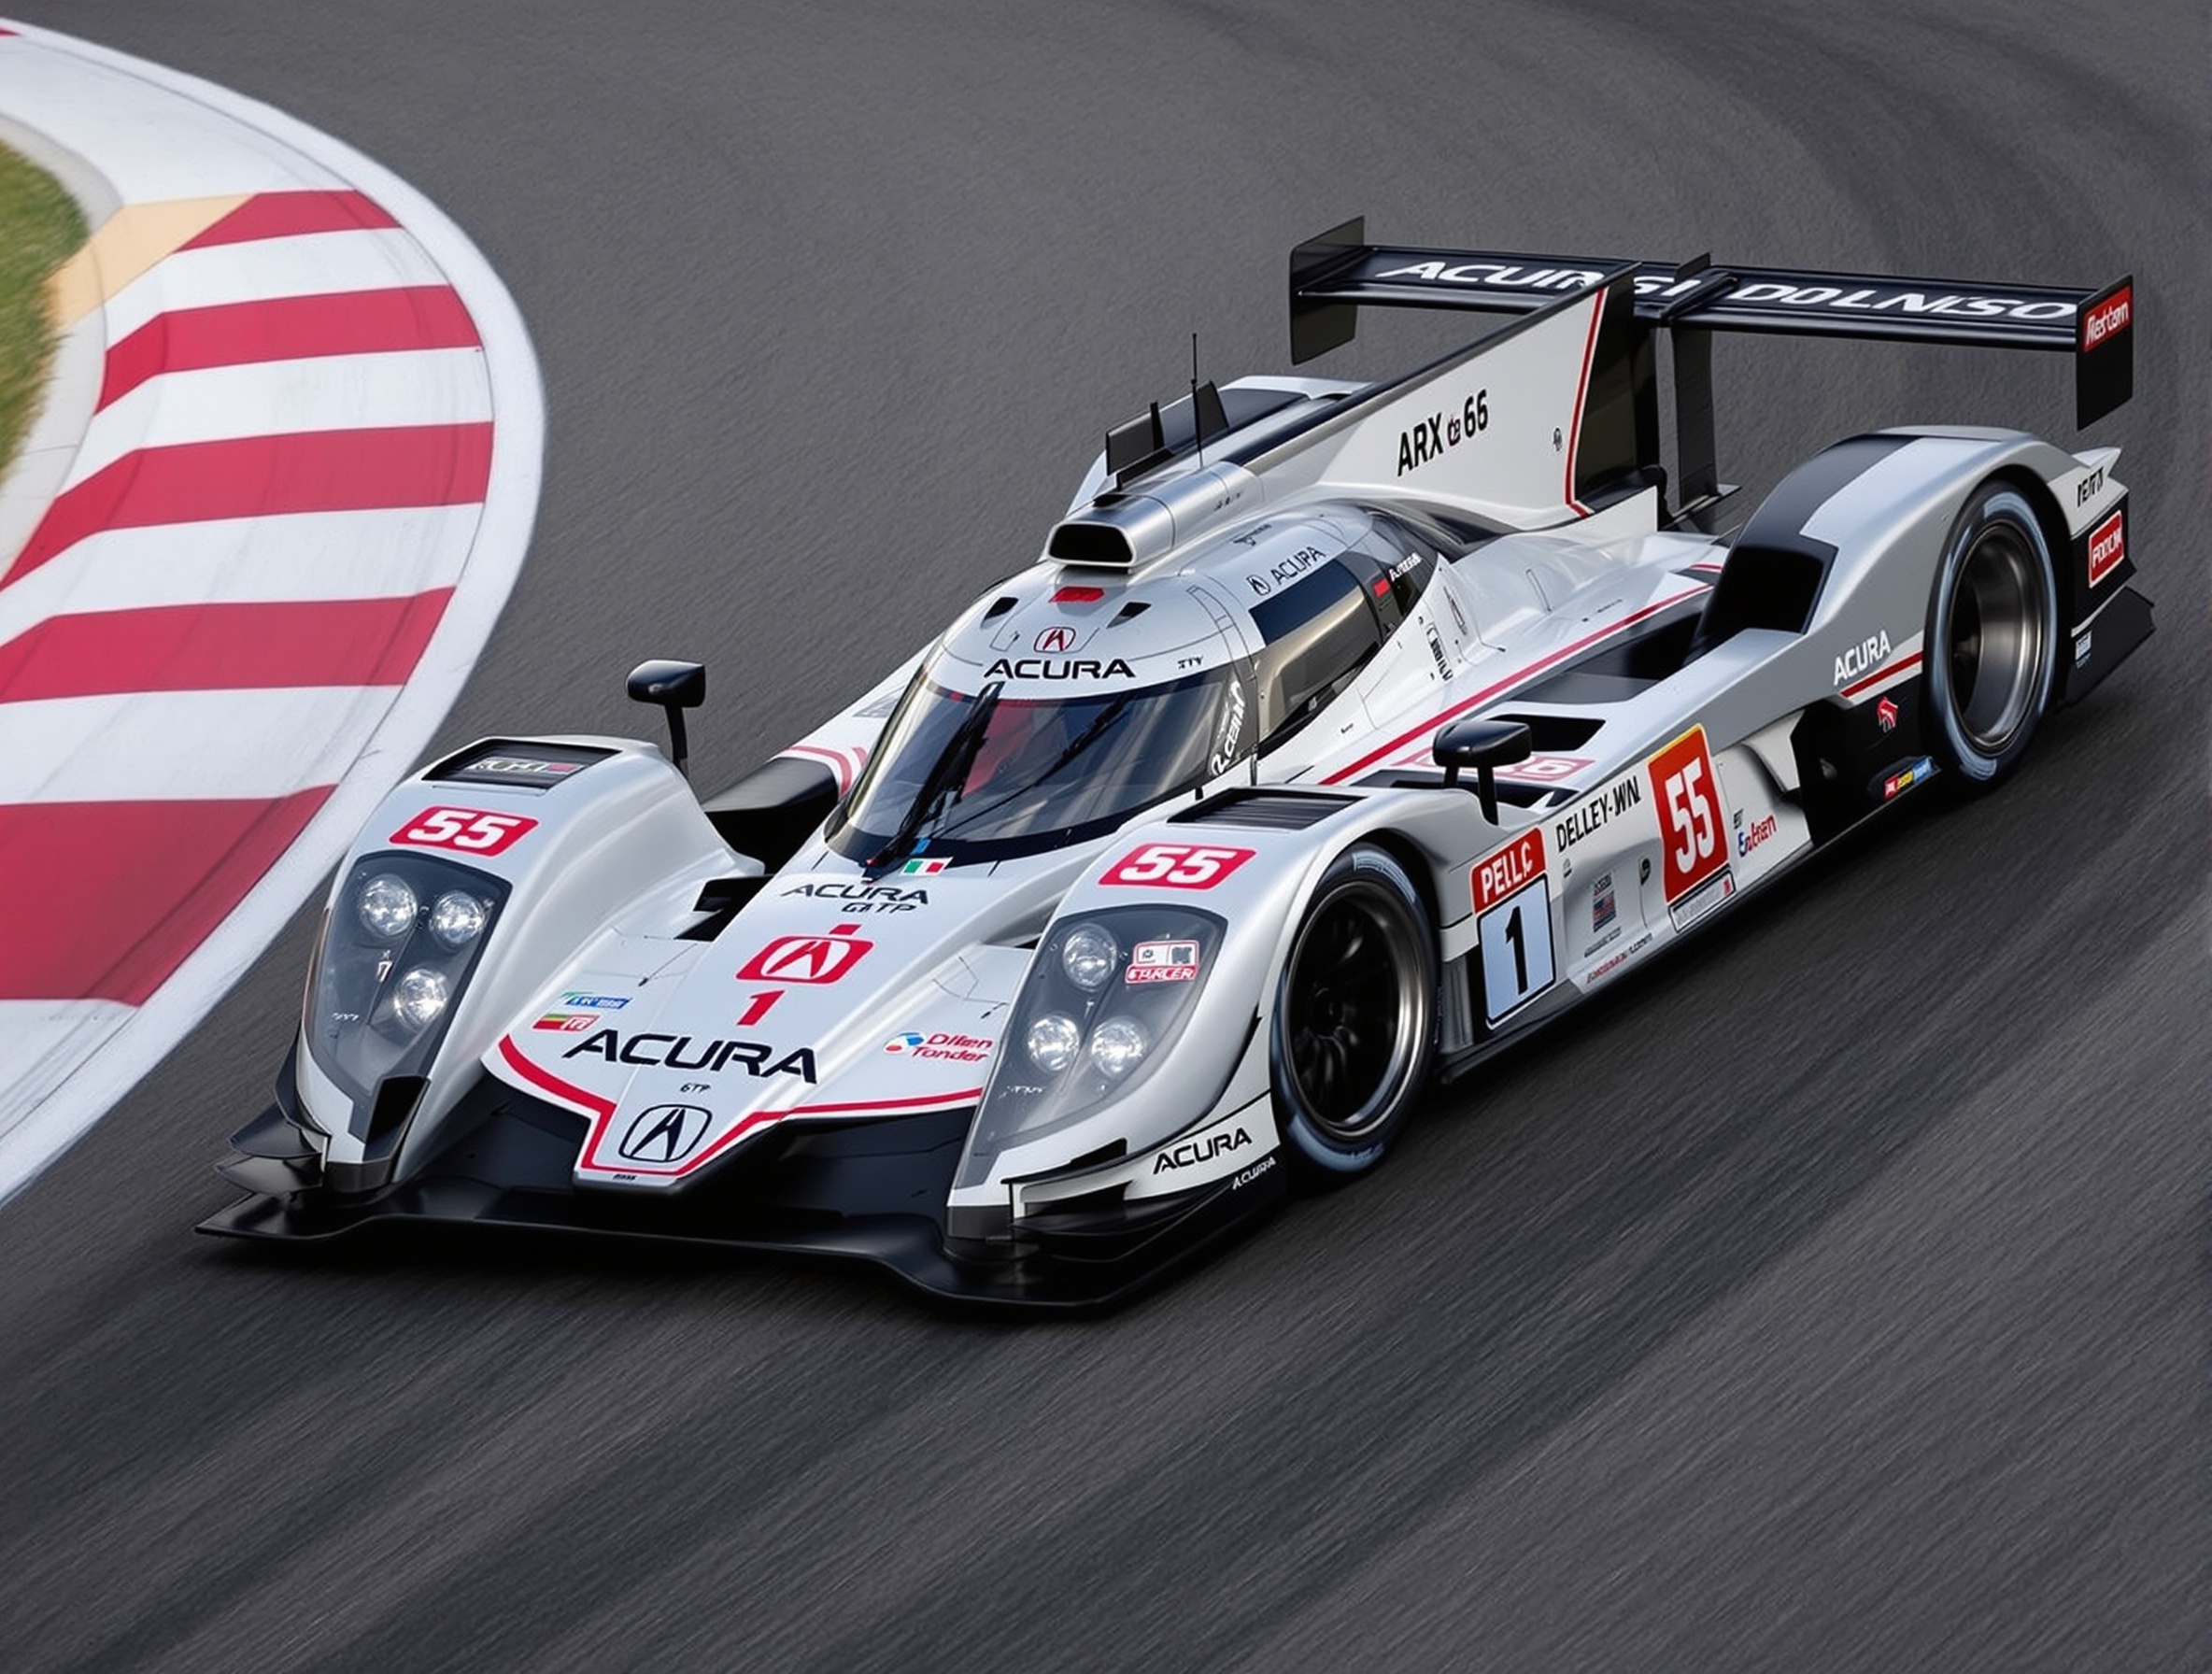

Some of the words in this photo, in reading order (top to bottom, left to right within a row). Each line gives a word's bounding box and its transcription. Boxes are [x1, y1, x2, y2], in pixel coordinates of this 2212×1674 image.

[1397, 412, 1443, 476] ARX
[984, 659, 1136, 679] ACURA
[1834, 630, 1891, 687] ACURA
[407, 810, 522, 849] 55
[1665, 757, 1715, 873] 55
[1119, 846, 1237, 885] 55
[781, 884, 929, 905] ACURA
[1505, 905, 1528, 996] 1
[736, 989, 786, 1027] 1
[561, 1029, 817, 1085] ACURA
[1153, 1127, 1253, 1175] ACURA
